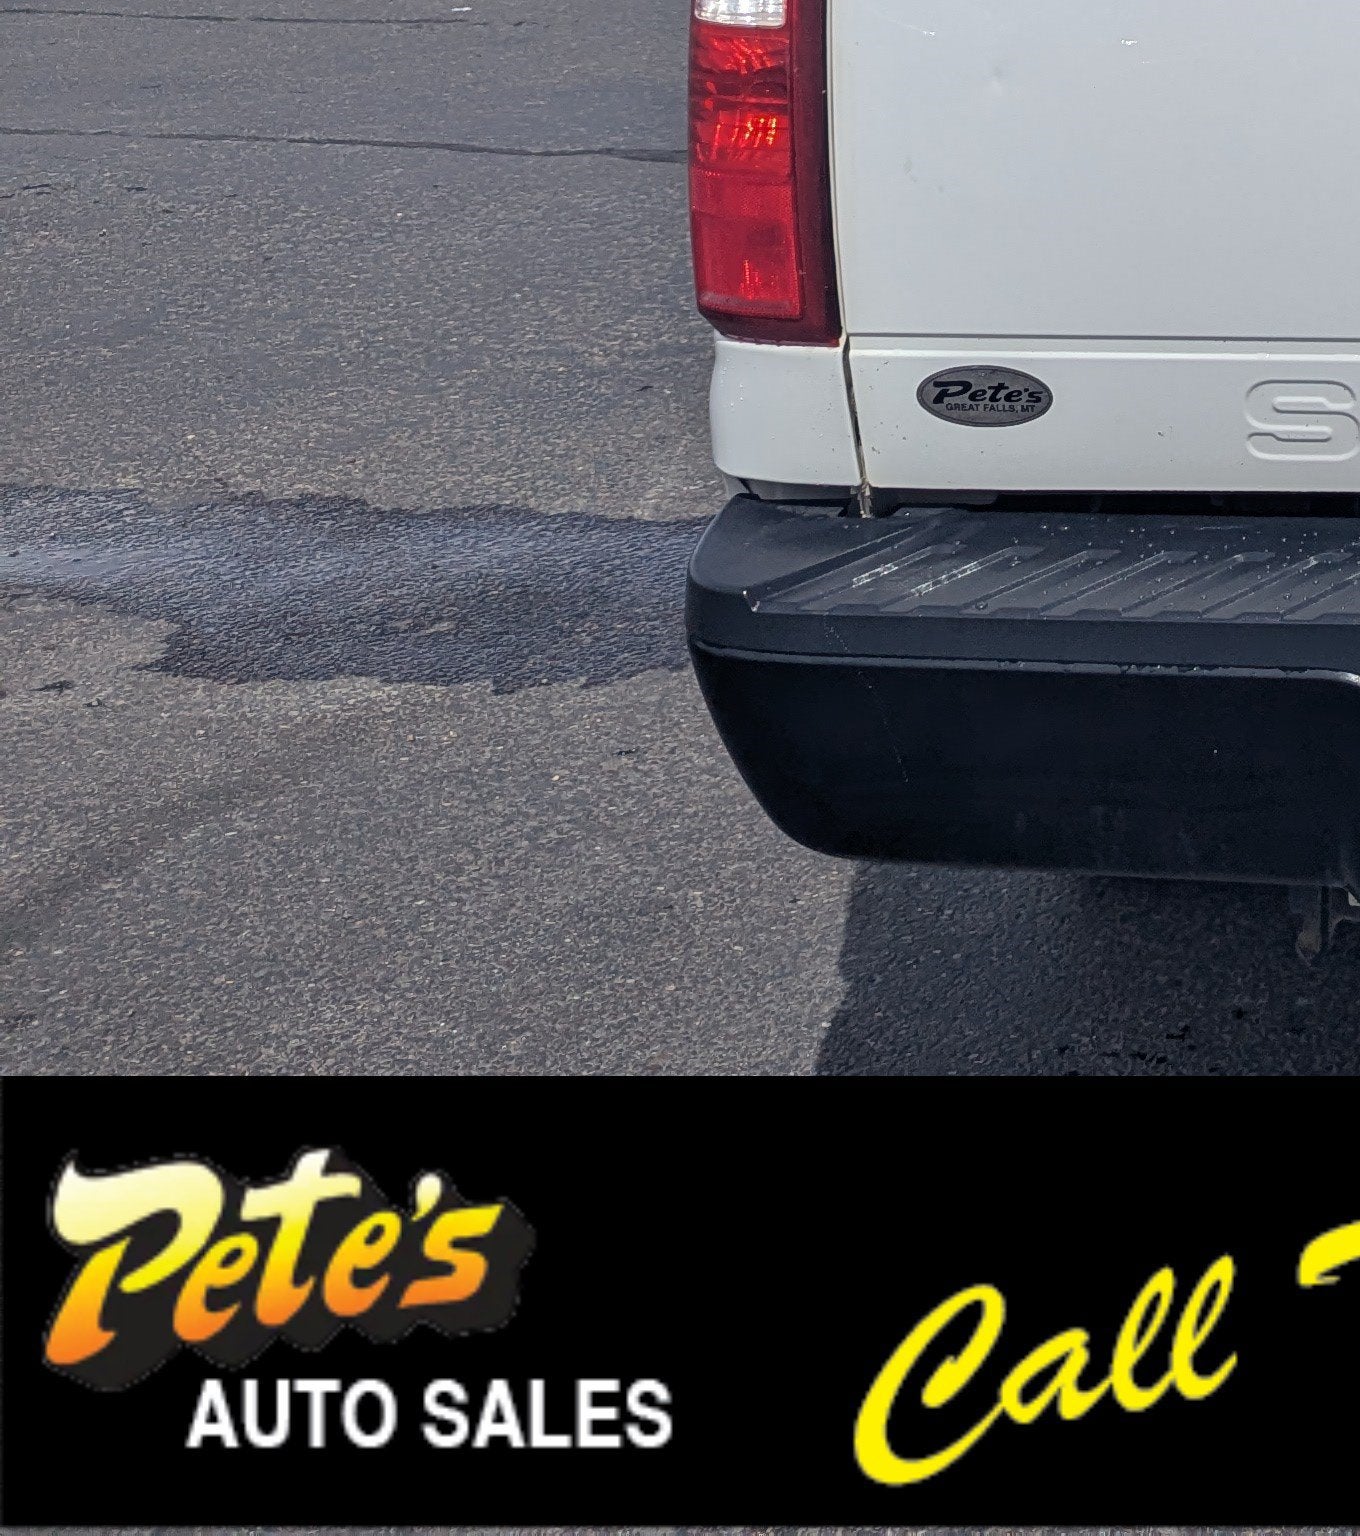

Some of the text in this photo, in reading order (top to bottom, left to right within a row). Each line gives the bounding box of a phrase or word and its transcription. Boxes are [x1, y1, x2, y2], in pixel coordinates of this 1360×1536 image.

[932, 380, 1043, 405] Pete's
[945, 403, 1036, 414] GREAT FALLS, MT
